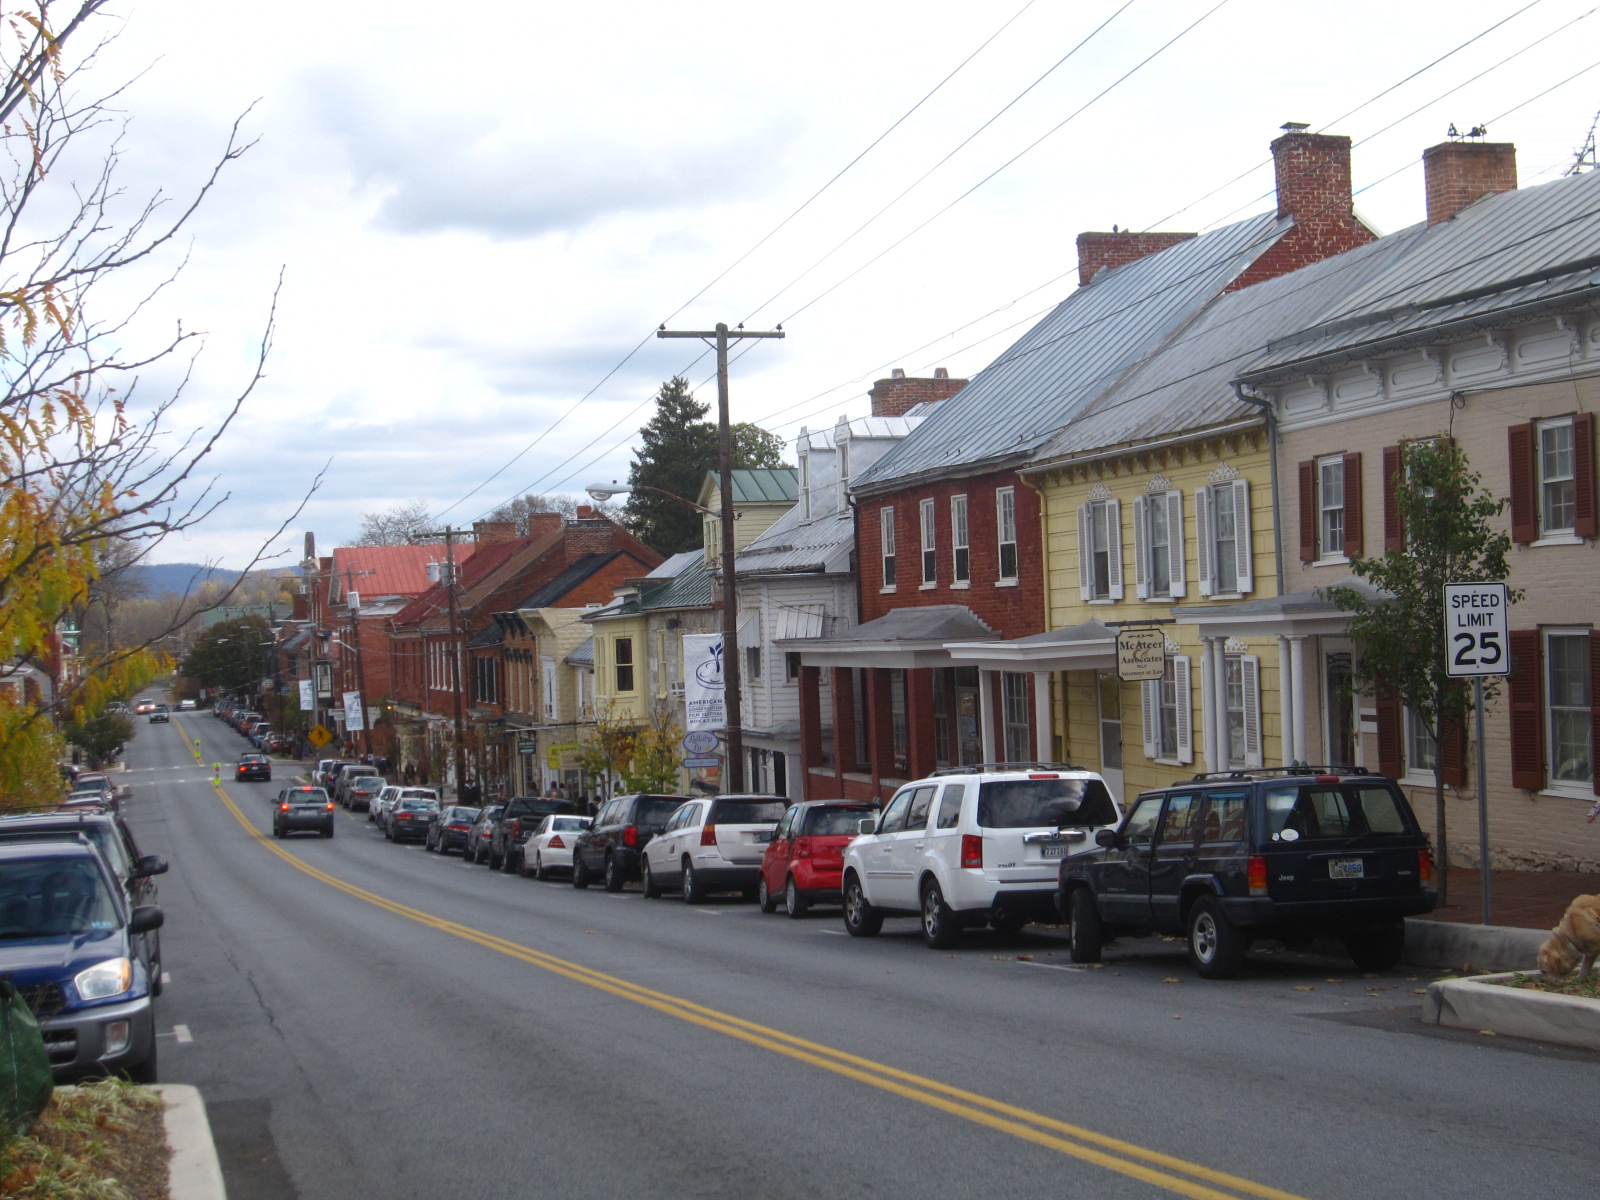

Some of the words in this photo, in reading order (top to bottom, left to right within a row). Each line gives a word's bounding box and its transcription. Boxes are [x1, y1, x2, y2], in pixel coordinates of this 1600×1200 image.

[1452, 594, 1499, 608] SPEED
[1458, 613, 1494, 627] LIMIT
[1119, 640, 1163, 650] McAteer
[1453, 632, 1501, 665] 25
[1121, 656, 1162, 664] Associates
